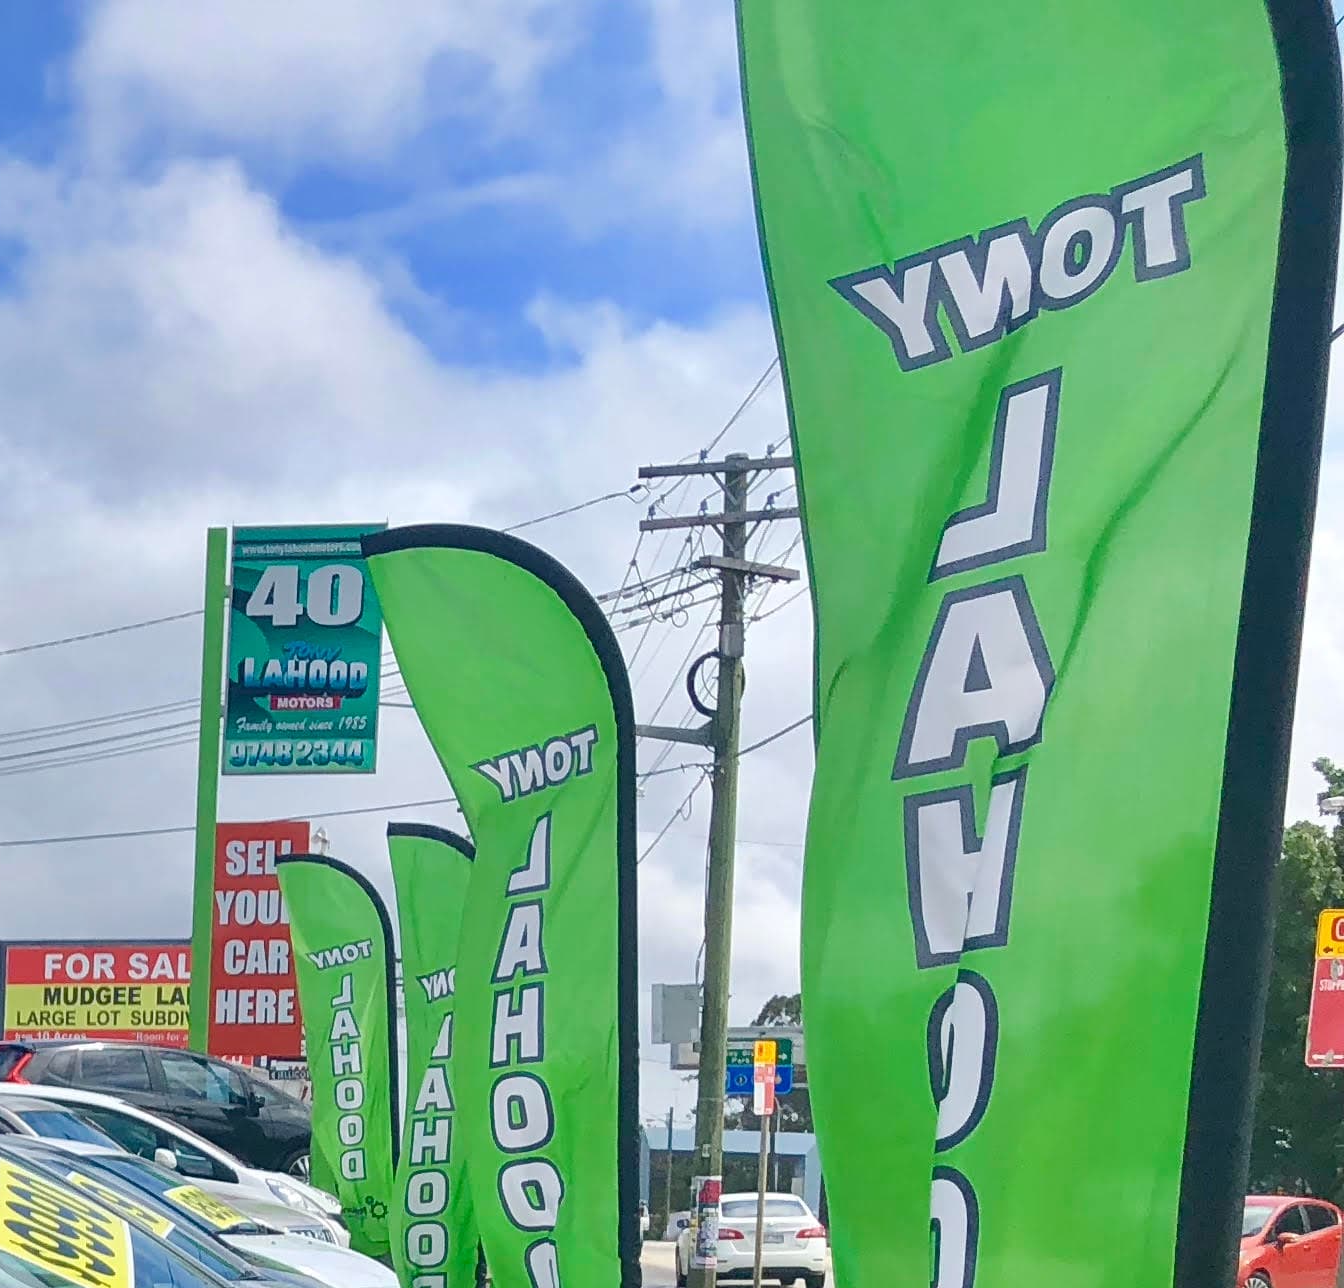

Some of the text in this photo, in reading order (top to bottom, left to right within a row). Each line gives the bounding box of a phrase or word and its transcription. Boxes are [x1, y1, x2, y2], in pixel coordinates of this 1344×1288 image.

[246, 565, 363, 627] 40
[237, 657, 368, 695] LAHOOD
[277, 697, 334, 708] MOTORS
[236, 716, 368, 733] Family owned since 1985
[44, 953, 116, 980] FOR
[223, 939, 289, 975] CAR
[43, 987, 190, 1006] MUDGEE LA
[215, 989, 295, 1024] HERE
[16, 1011, 76, 1026] LARGE
[87, 1011, 120, 1026] LOT
[4, 1171, 116, 1288] $9990
